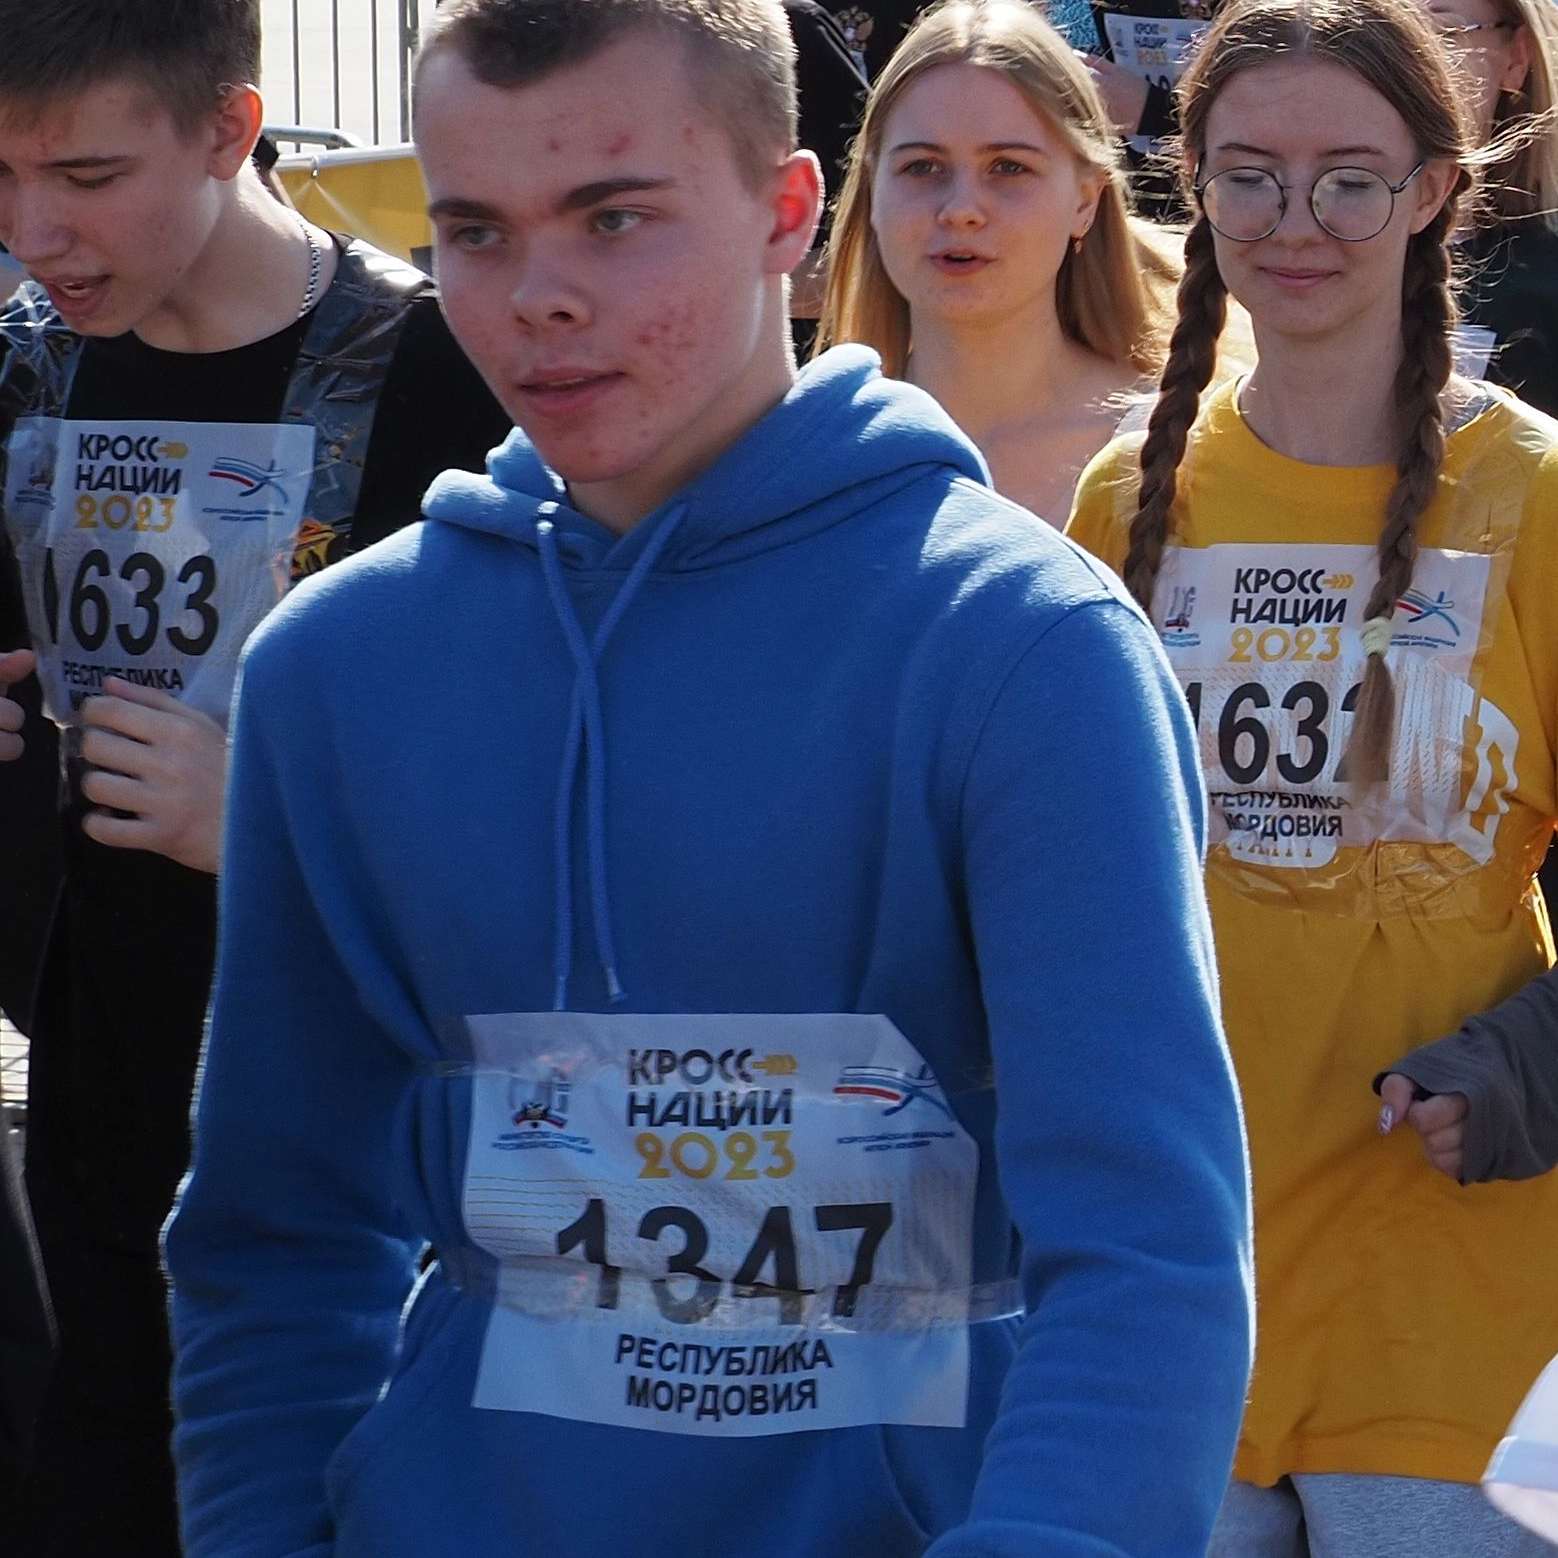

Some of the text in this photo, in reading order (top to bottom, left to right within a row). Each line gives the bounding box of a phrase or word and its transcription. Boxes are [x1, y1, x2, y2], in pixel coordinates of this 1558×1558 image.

[78, 433, 160, 462] КРОСС
[74, 464, 183, 496] НАЦИИ
[74, 494, 178, 533] 2023
[1234, 568, 1325, 595] КРОСС
[1230, 597, 1348, 627] НАЦИИ
[1226, 626, 1341, 663] 2023
[1224, 813, 1343, 842] МОРДОВИЯ
[627, 1047, 755, 1086] КРОСС
[627, 1088, 794, 1130] НАЦИИ
[634, 1131, 796, 1181] 2023
[556, 1198, 894, 1326] 1347
[615, 1333, 834, 1376] РЕСПУБЛИКА
[625, 1376, 820, 1422] МОРДОВИЯ
